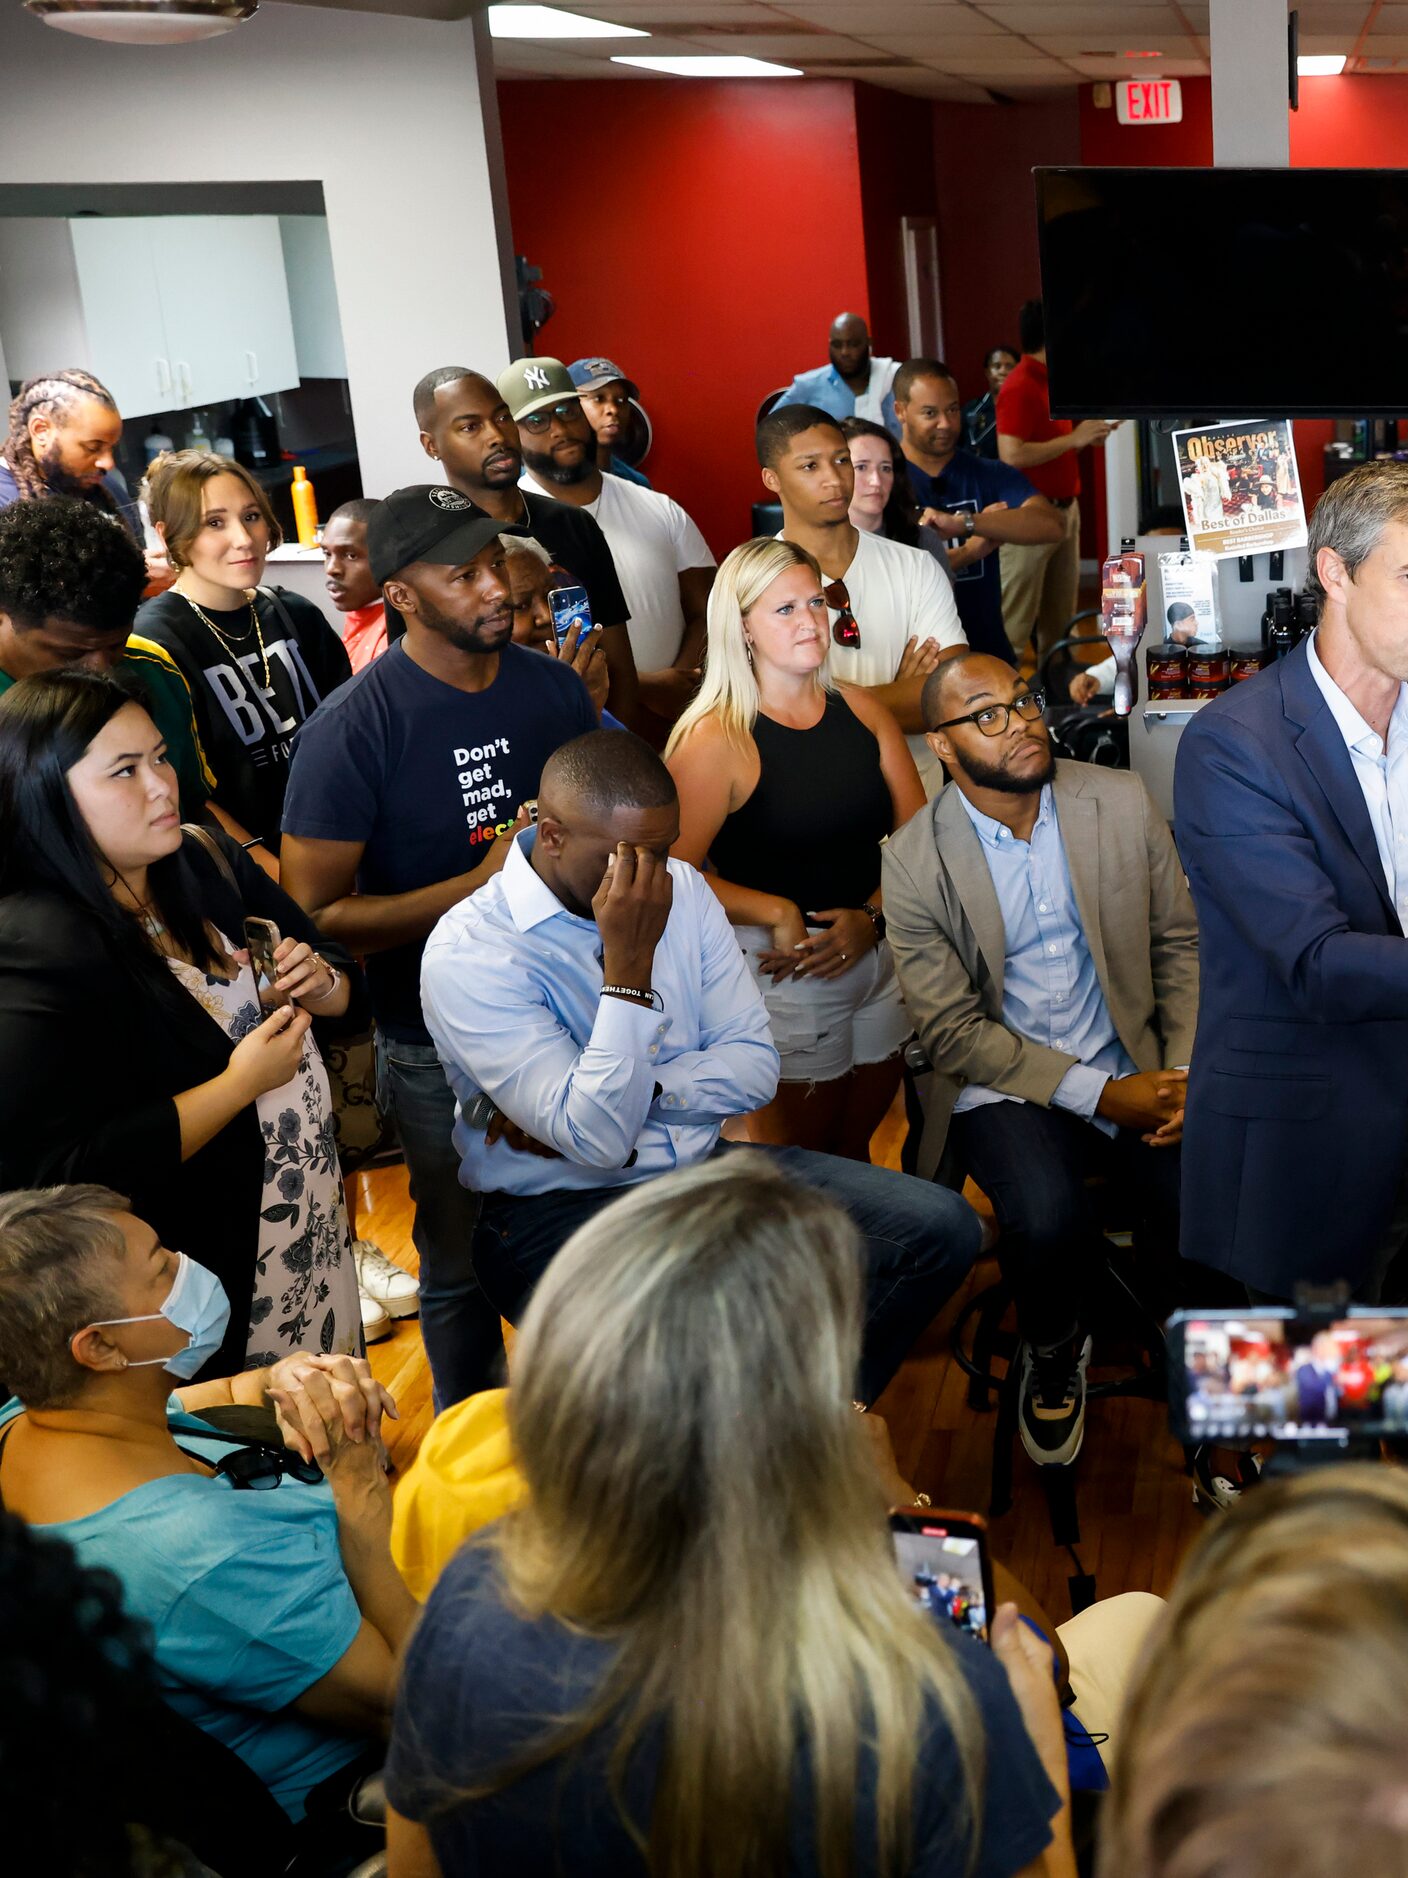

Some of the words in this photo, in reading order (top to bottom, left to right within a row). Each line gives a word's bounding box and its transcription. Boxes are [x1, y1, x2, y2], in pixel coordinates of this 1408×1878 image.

[1127, 82, 1172, 119] EXIT
[1201, 517, 1231, 531] Best
[1233, 514, 1246, 526] of
[1248, 510, 1287, 524] Dallas
[271, 737, 294, 762] FO
[453, 738, 511, 766] Don't
[458, 763, 493, 789] get
[462, 779, 512, 806] mad,
[466, 803, 497, 829] get
